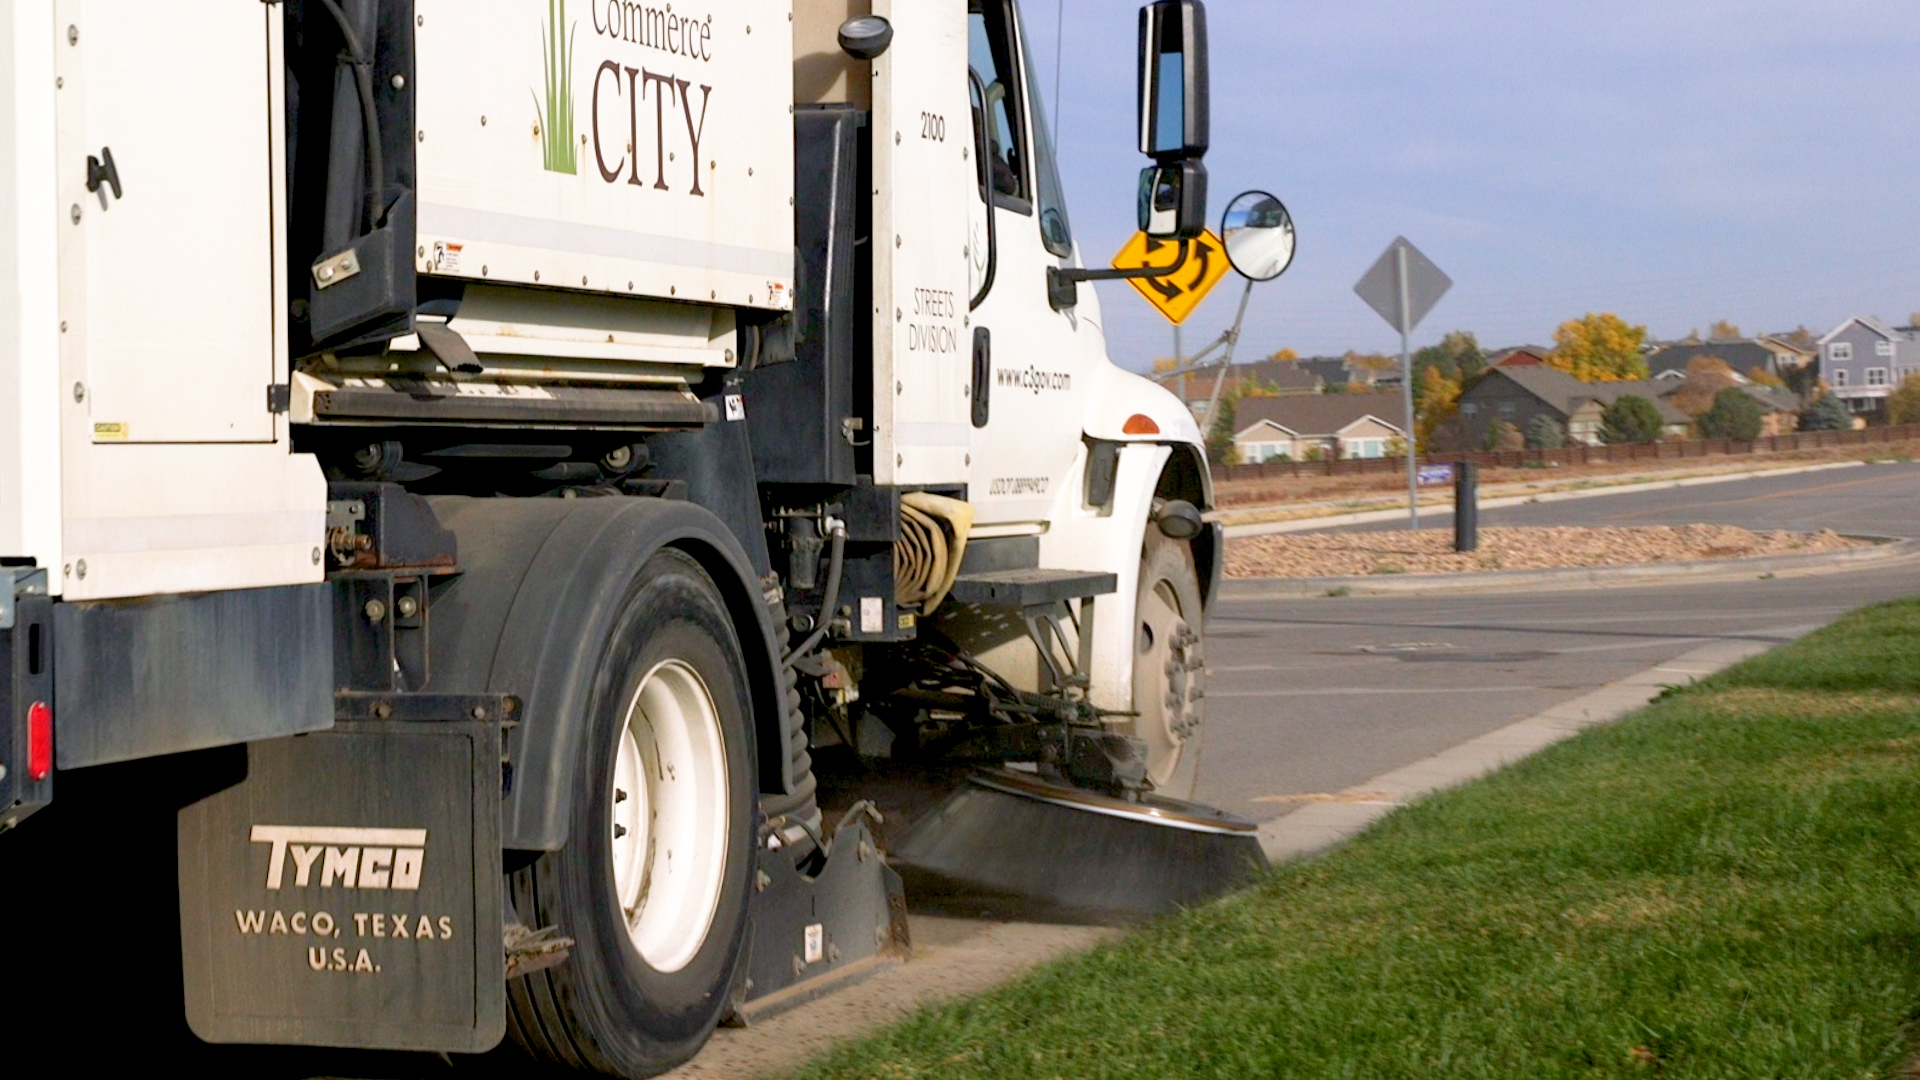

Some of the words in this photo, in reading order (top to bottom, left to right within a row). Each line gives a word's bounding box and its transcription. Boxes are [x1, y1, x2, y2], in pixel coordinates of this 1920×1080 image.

[592, 0, 711, 62] Commerce
[592, 59, 712, 197] CITY
[921, 111, 946, 143] 2100
[914, 287, 954, 318] STREETS
[909, 323, 957, 353] DIVISION
[997, 364, 1071, 395] www.c3gov.com
[250, 825, 427, 890] TYMCO
[235, 909, 341, 939] WACO,
[354, 913, 453, 940] TEXAS
[308, 946, 382, 973] U.S.A.
